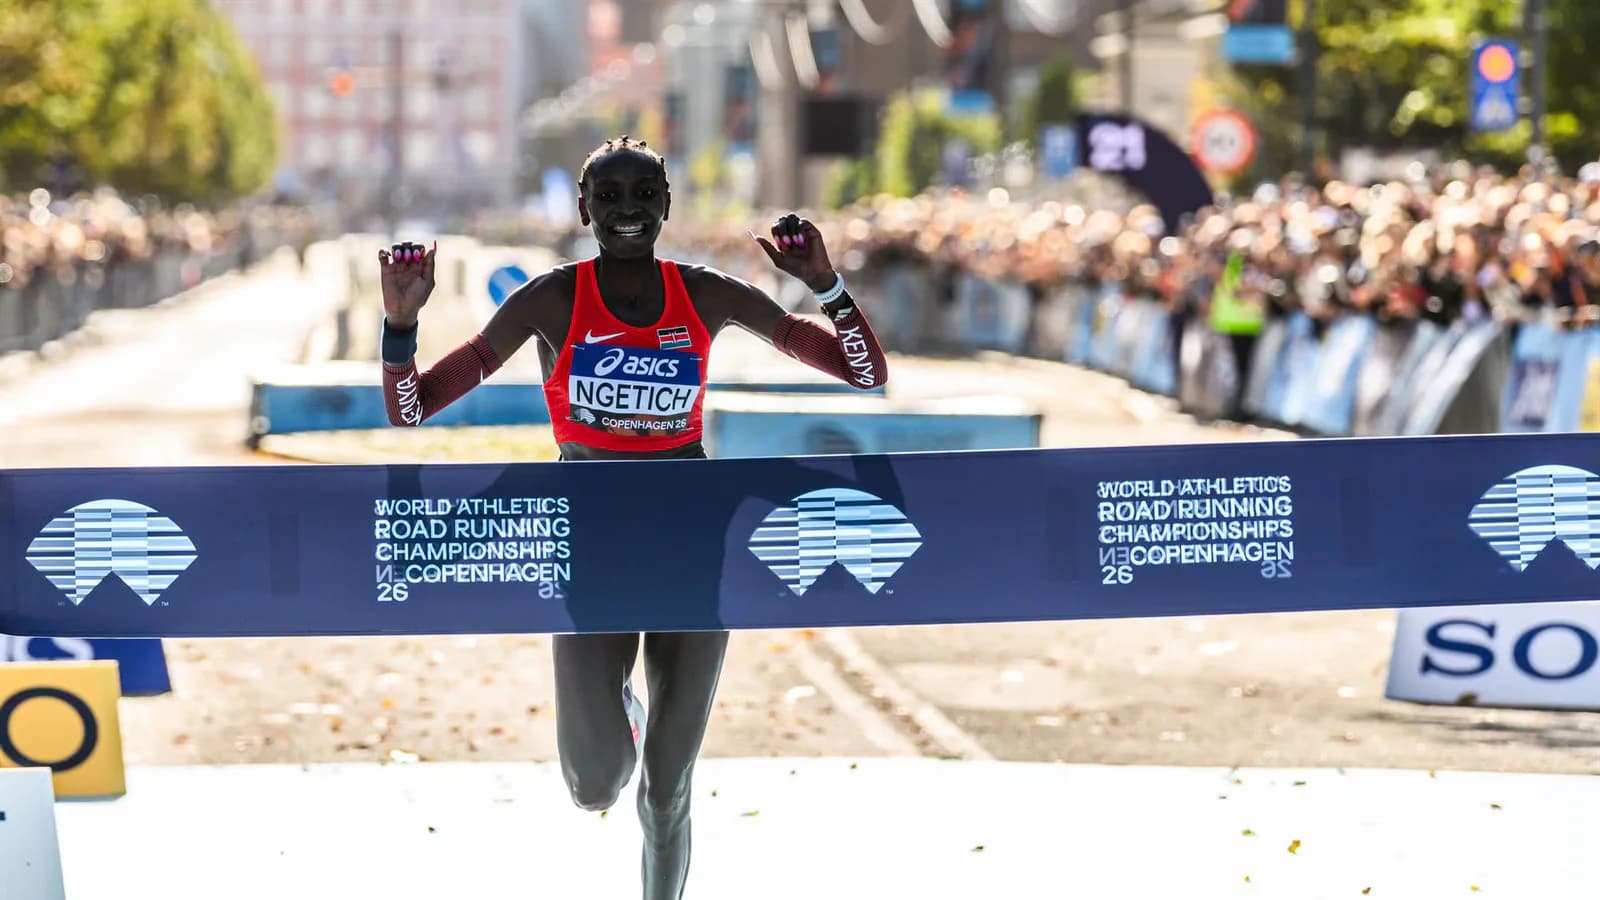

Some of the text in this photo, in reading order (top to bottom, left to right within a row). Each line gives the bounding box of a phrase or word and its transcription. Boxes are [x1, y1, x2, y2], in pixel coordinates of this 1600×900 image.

[839, 326, 875, 386] KENYA
[576, 380, 692, 412] NGETICH
[602, 416, 687, 430] COPENHAGEN 26
[1099, 476, 1291, 498] WORLD ATHLETICS
[375, 497, 570, 516] WORLD ATHLETICS
[1099, 496, 1293, 522] ROAD RUNNING
[375, 517, 570, 539] ROAD RUNNING
[1100, 519, 1294, 544] CHAMPIONSHIPS
[375, 541, 571, 560] CHAMPIONSHIPS
[1130, 541, 1294, 566] COPENHAGEN
[405, 562, 571, 583] COPENHAGEN
[1102, 565, 1134, 585] 26
[376, 583, 409, 602] 26
[1419, 619, 1599, 680] SO
